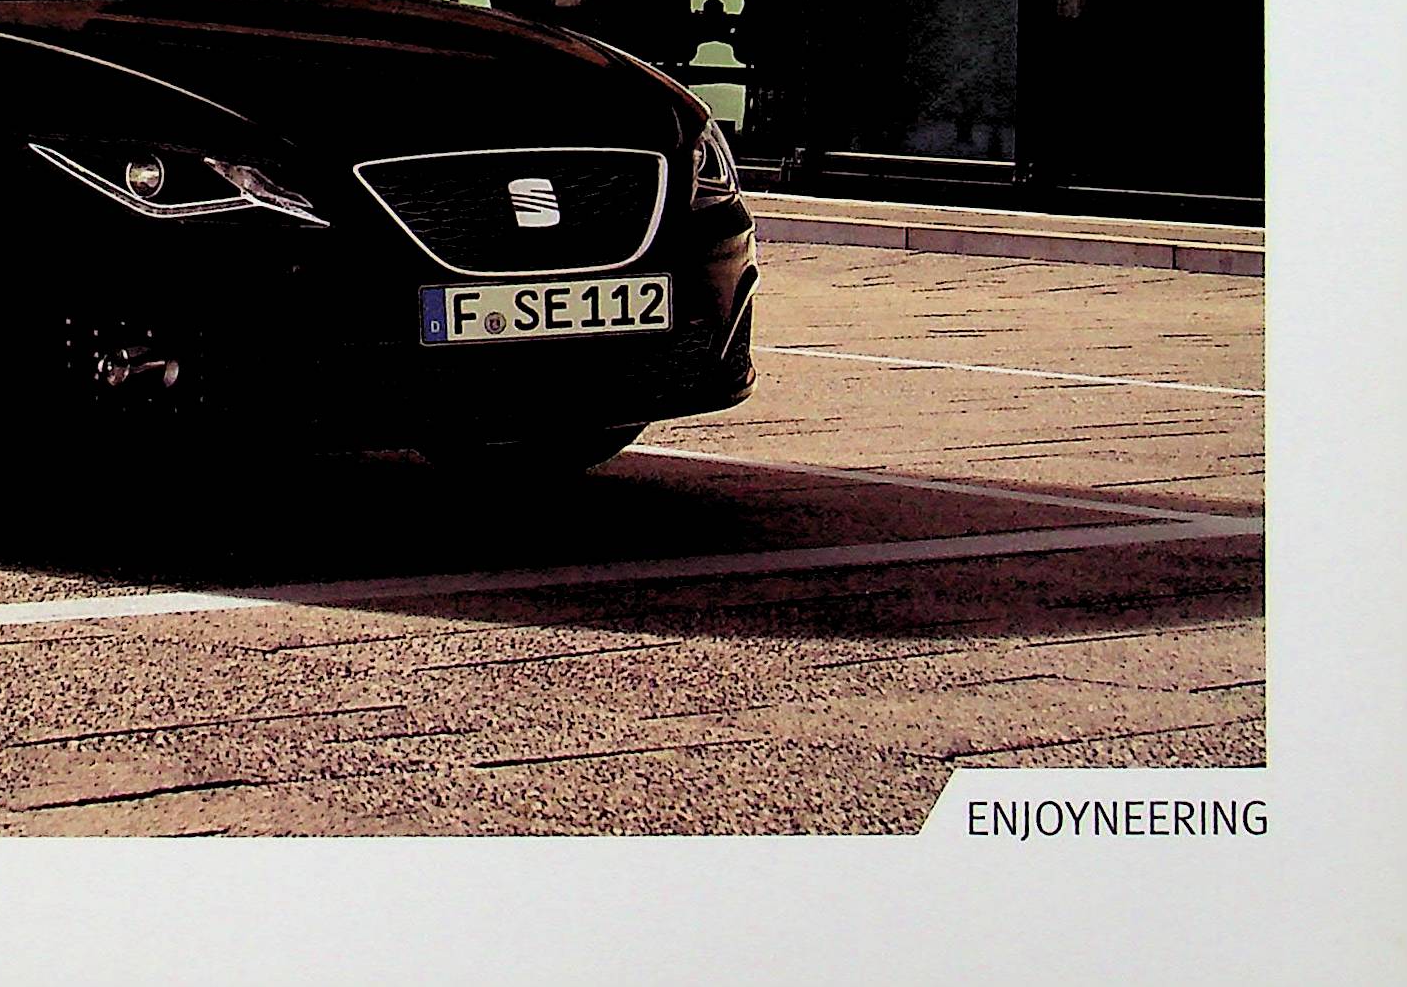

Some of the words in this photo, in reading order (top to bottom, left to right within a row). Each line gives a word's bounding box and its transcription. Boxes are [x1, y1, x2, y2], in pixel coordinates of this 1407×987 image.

[431, 321, 440, 333] D
[453, 293, 481, 334] F
[968, 800, 1268, 840] ENJOYNEERING
